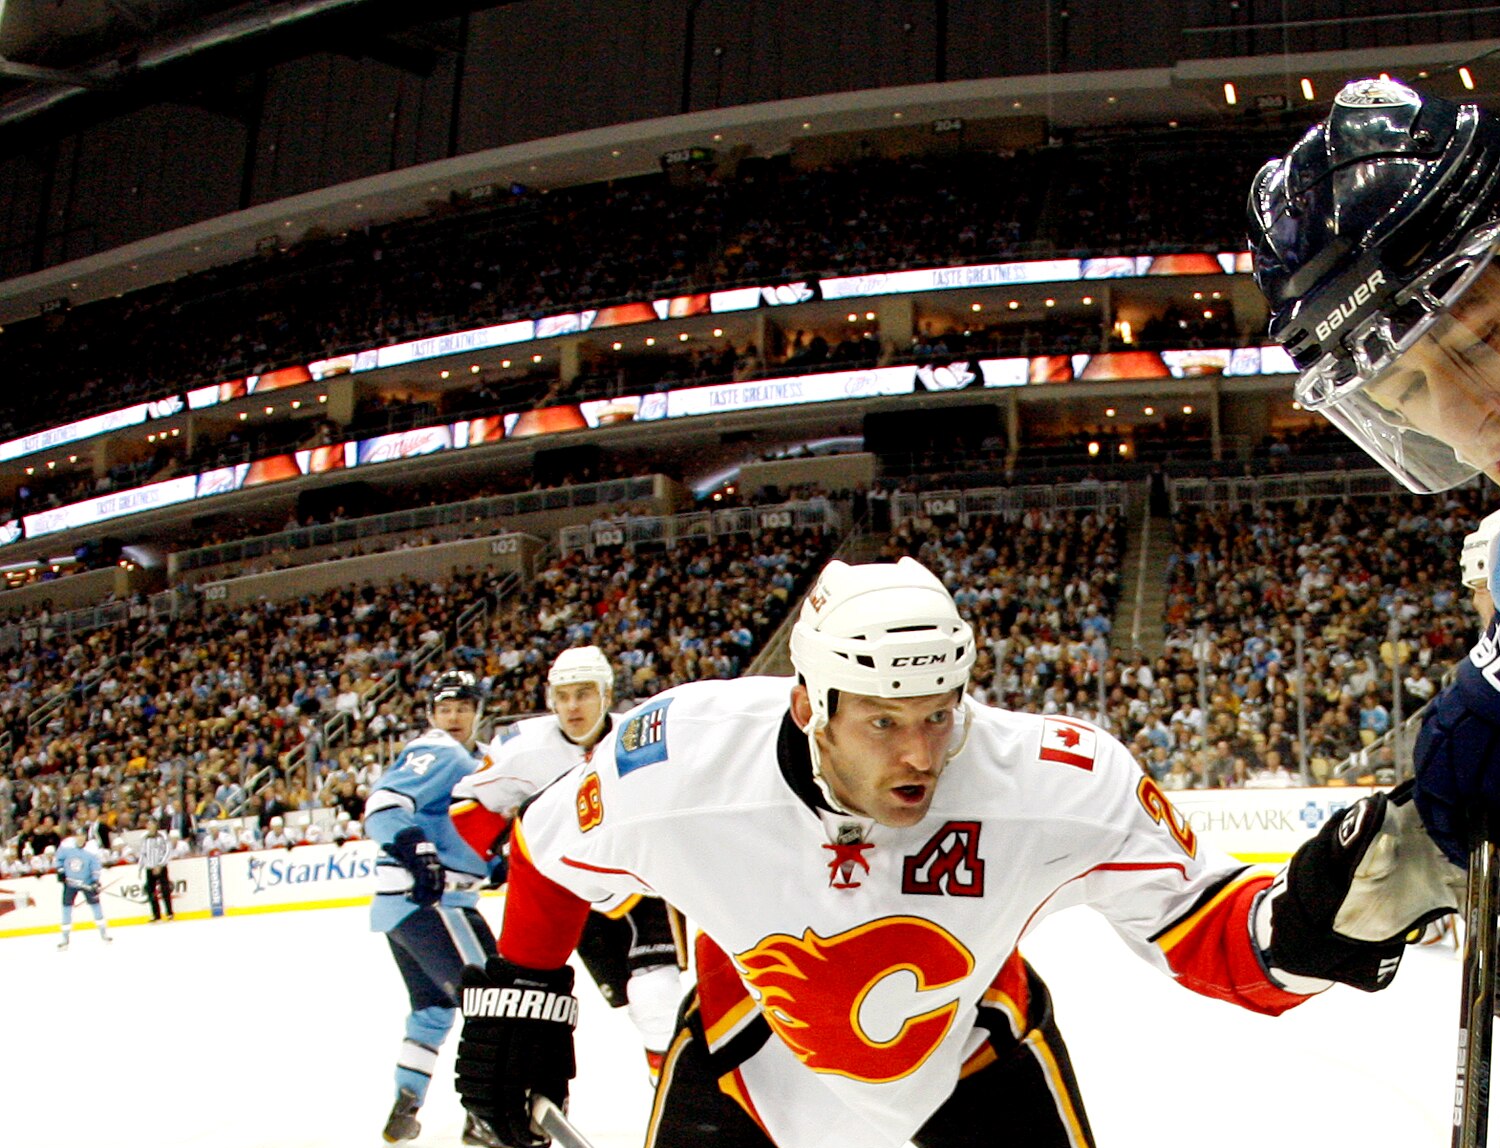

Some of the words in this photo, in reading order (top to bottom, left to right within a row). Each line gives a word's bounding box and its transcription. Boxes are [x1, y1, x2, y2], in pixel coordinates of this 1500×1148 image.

[926, 499, 955, 514] 104
[761, 513, 790, 528] 103
[891, 653, 948, 668] CCM
[1189, 809, 1296, 833] GHMARK
[901, 820, 985, 898] A
